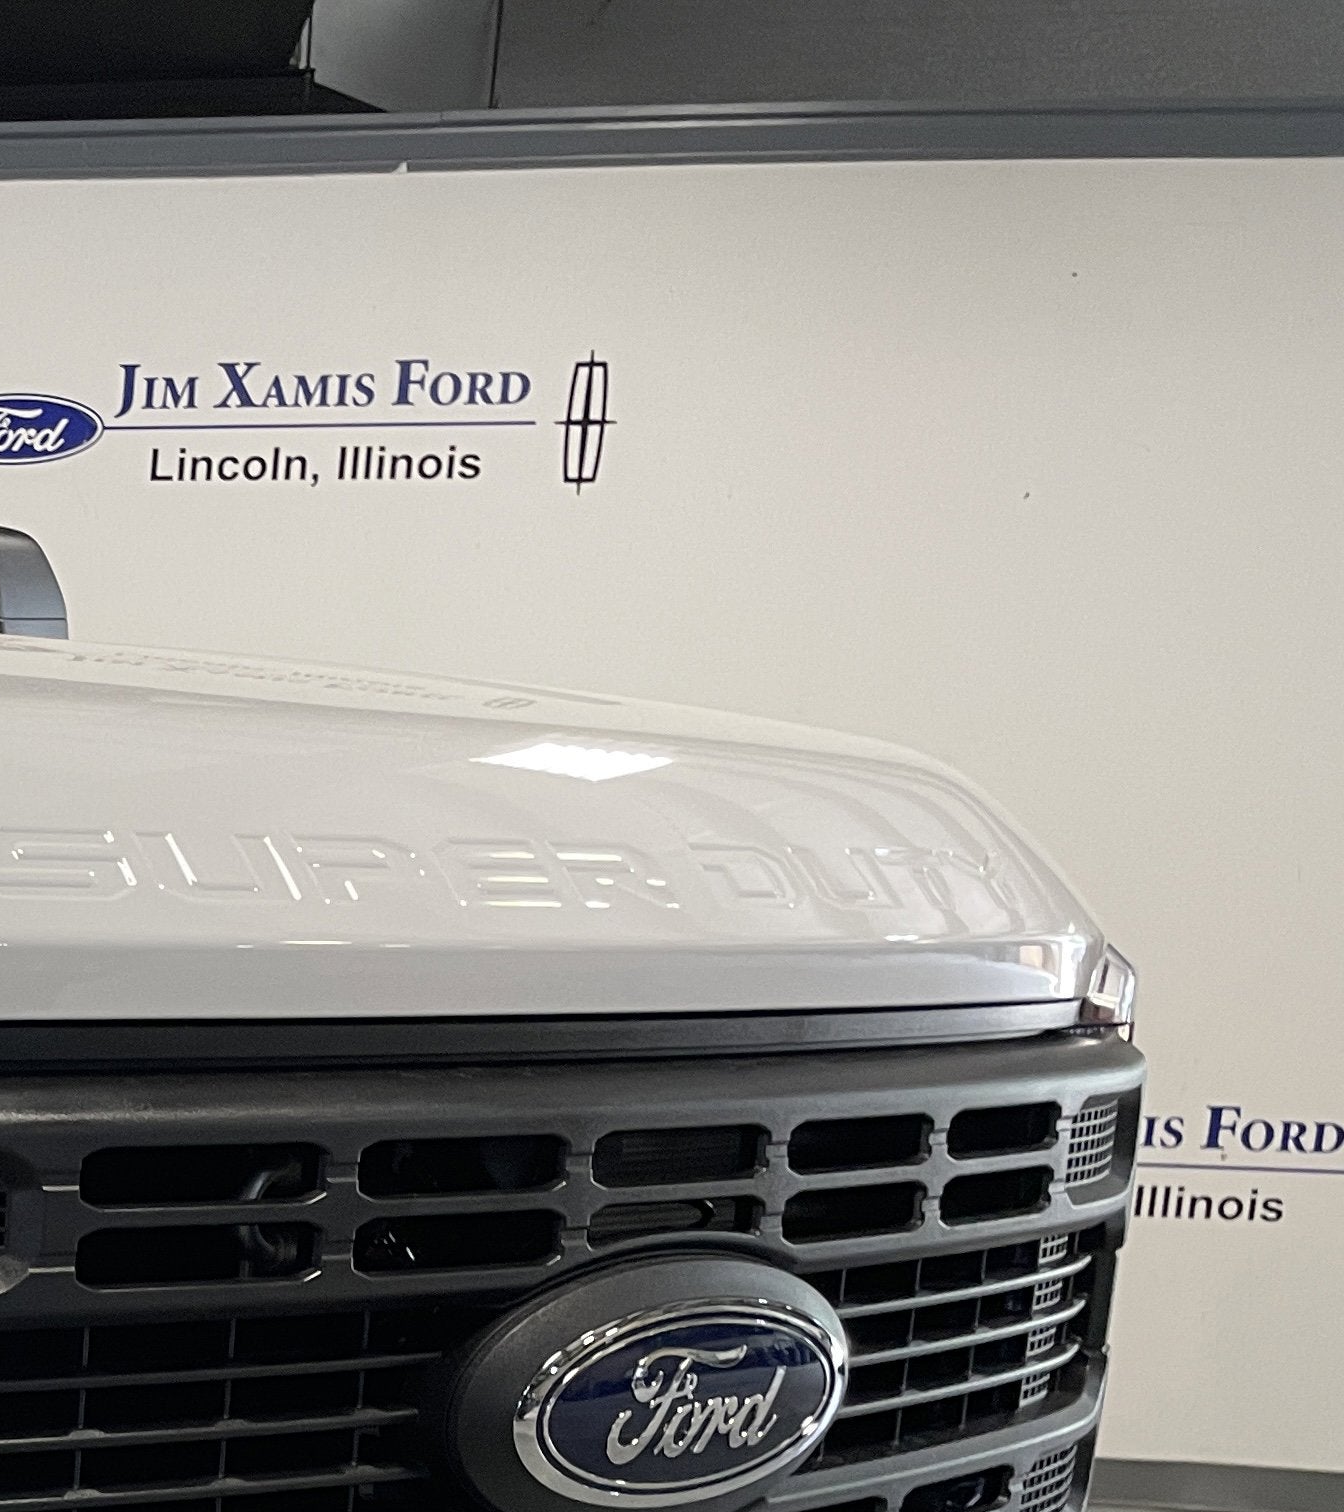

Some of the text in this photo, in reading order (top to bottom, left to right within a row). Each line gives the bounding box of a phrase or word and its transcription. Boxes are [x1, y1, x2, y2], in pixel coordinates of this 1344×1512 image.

[113, 363, 200, 418] JIM
[393, 359, 532, 407] FORD
[149, 446, 482, 487] Lincoln, Illinois
[686, 838, 1018, 912] DUTY
[1199, 1104, 1344, 1154] FORD
[1134, 1184, 1284, 1223] Illinois
[606, 1343, 787, 1466] Ford
